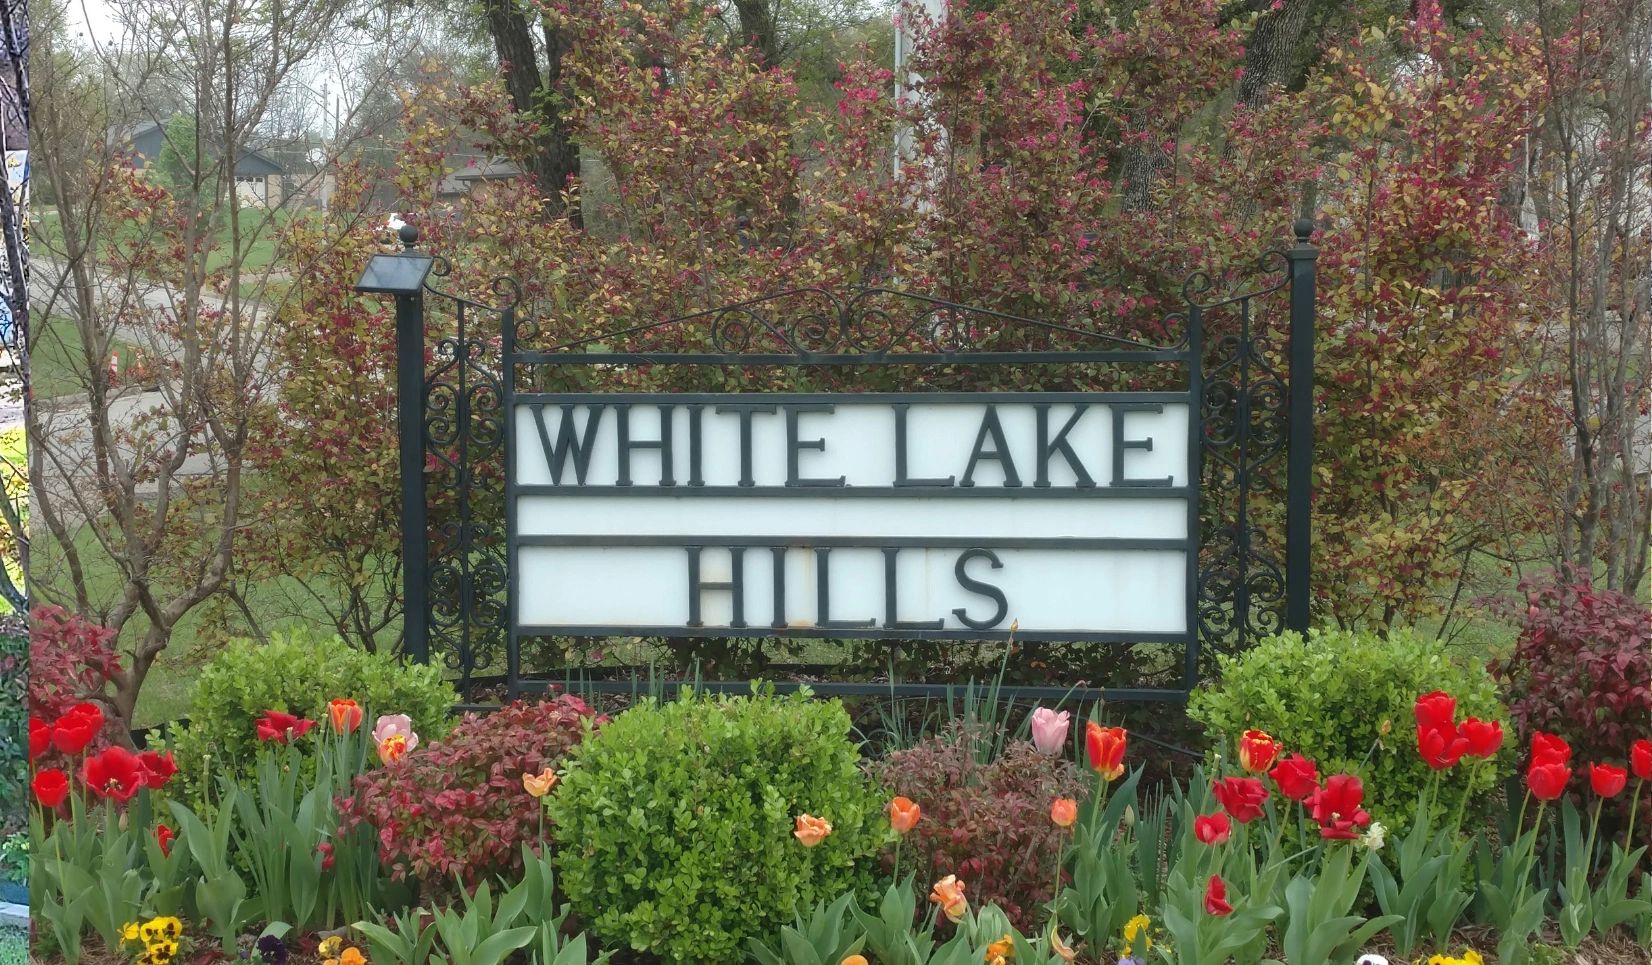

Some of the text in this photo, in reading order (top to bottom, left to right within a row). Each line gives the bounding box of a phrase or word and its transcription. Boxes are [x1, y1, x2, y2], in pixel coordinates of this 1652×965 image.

[529, 403, 1174, 487] WHITE LAKE
[685, 547, 1008, 629] HILLS
